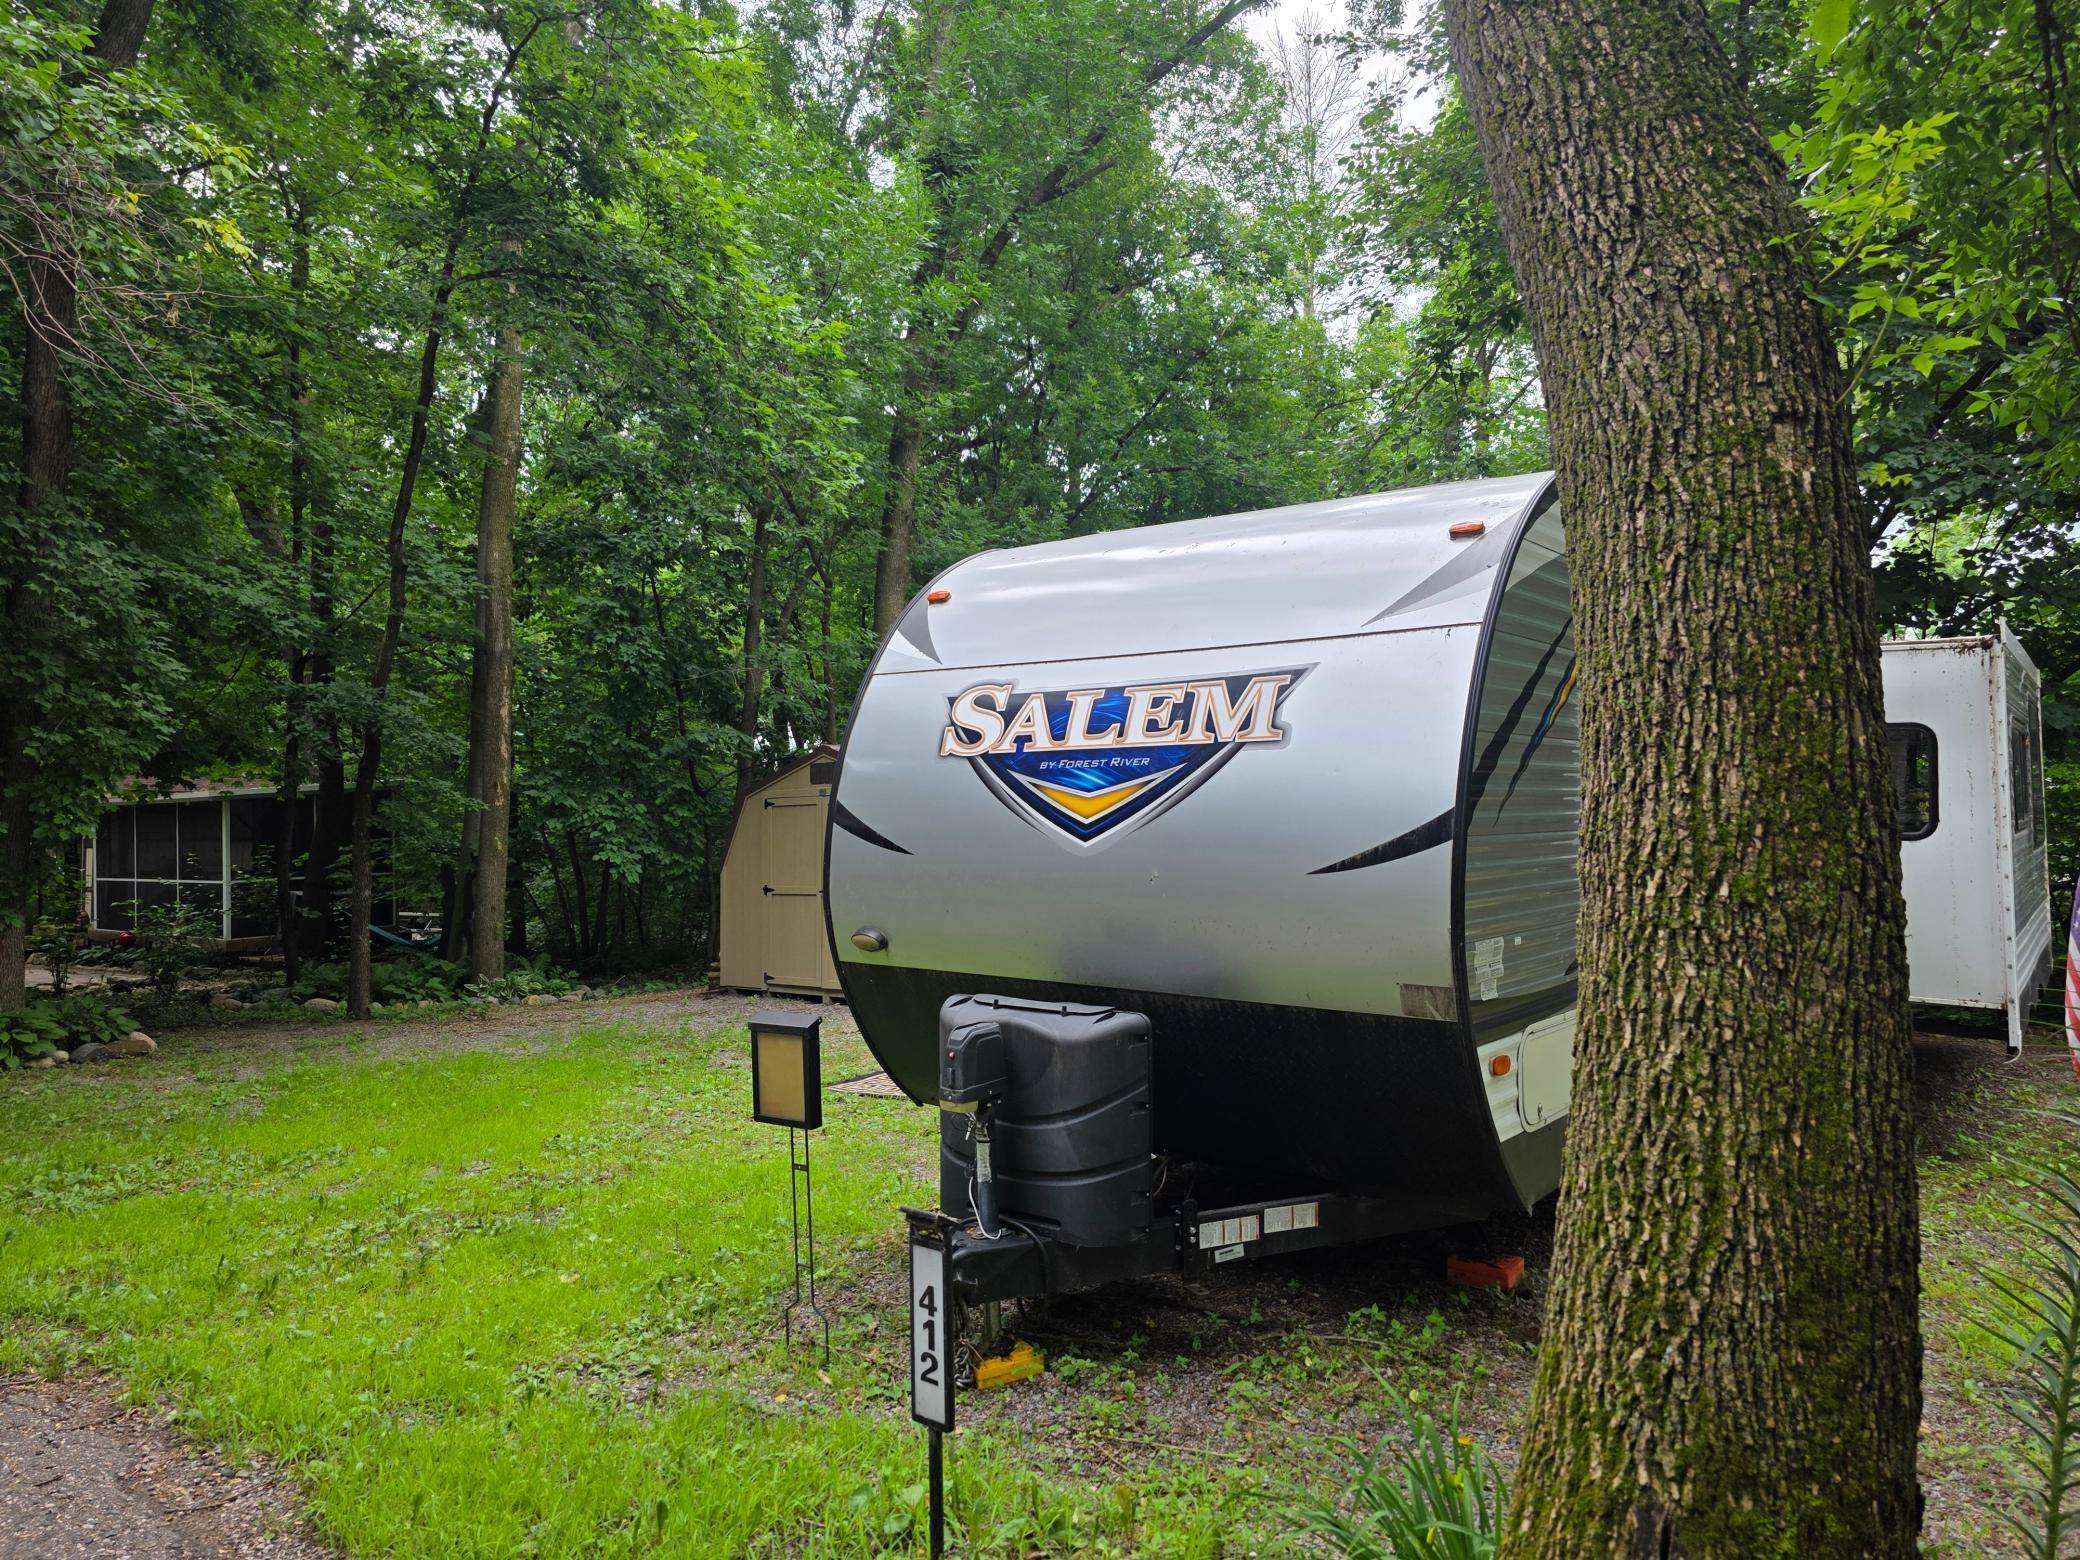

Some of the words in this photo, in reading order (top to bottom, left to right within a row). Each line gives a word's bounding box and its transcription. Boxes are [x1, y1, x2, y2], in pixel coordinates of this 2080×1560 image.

[941, 674, 1291, 756] SALEM
[1039, 761, 1057, 770] BY
[1058, 759, 1108, 769] FOREST
[1110, 757, 1151, 767] RIVER
[918, 1285, 939, 1386] 412
